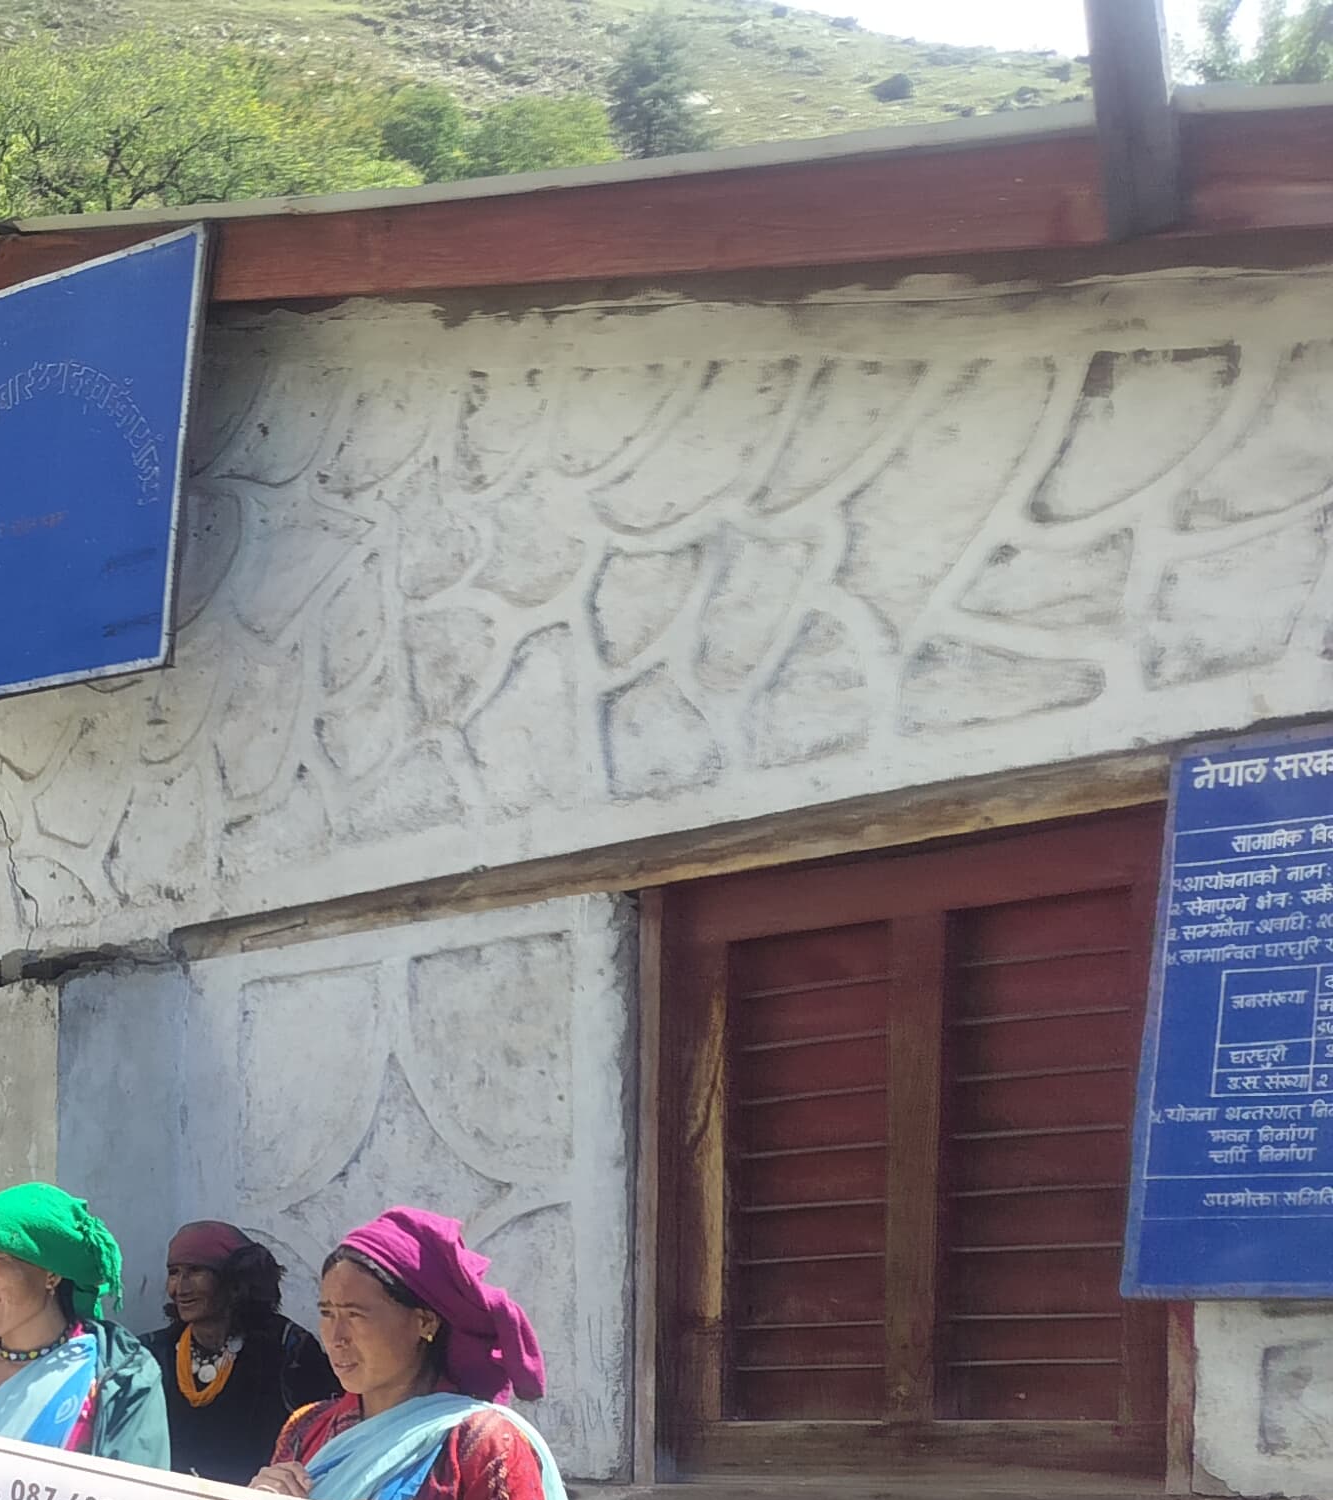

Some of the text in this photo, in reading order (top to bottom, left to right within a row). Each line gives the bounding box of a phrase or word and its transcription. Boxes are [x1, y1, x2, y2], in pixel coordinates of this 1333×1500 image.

[1192, 757, 1270, 789] नेपाल
[1231, 829, 1306, 853] सामाजिक
[1207, 1127, 1253, 1144] भवन
